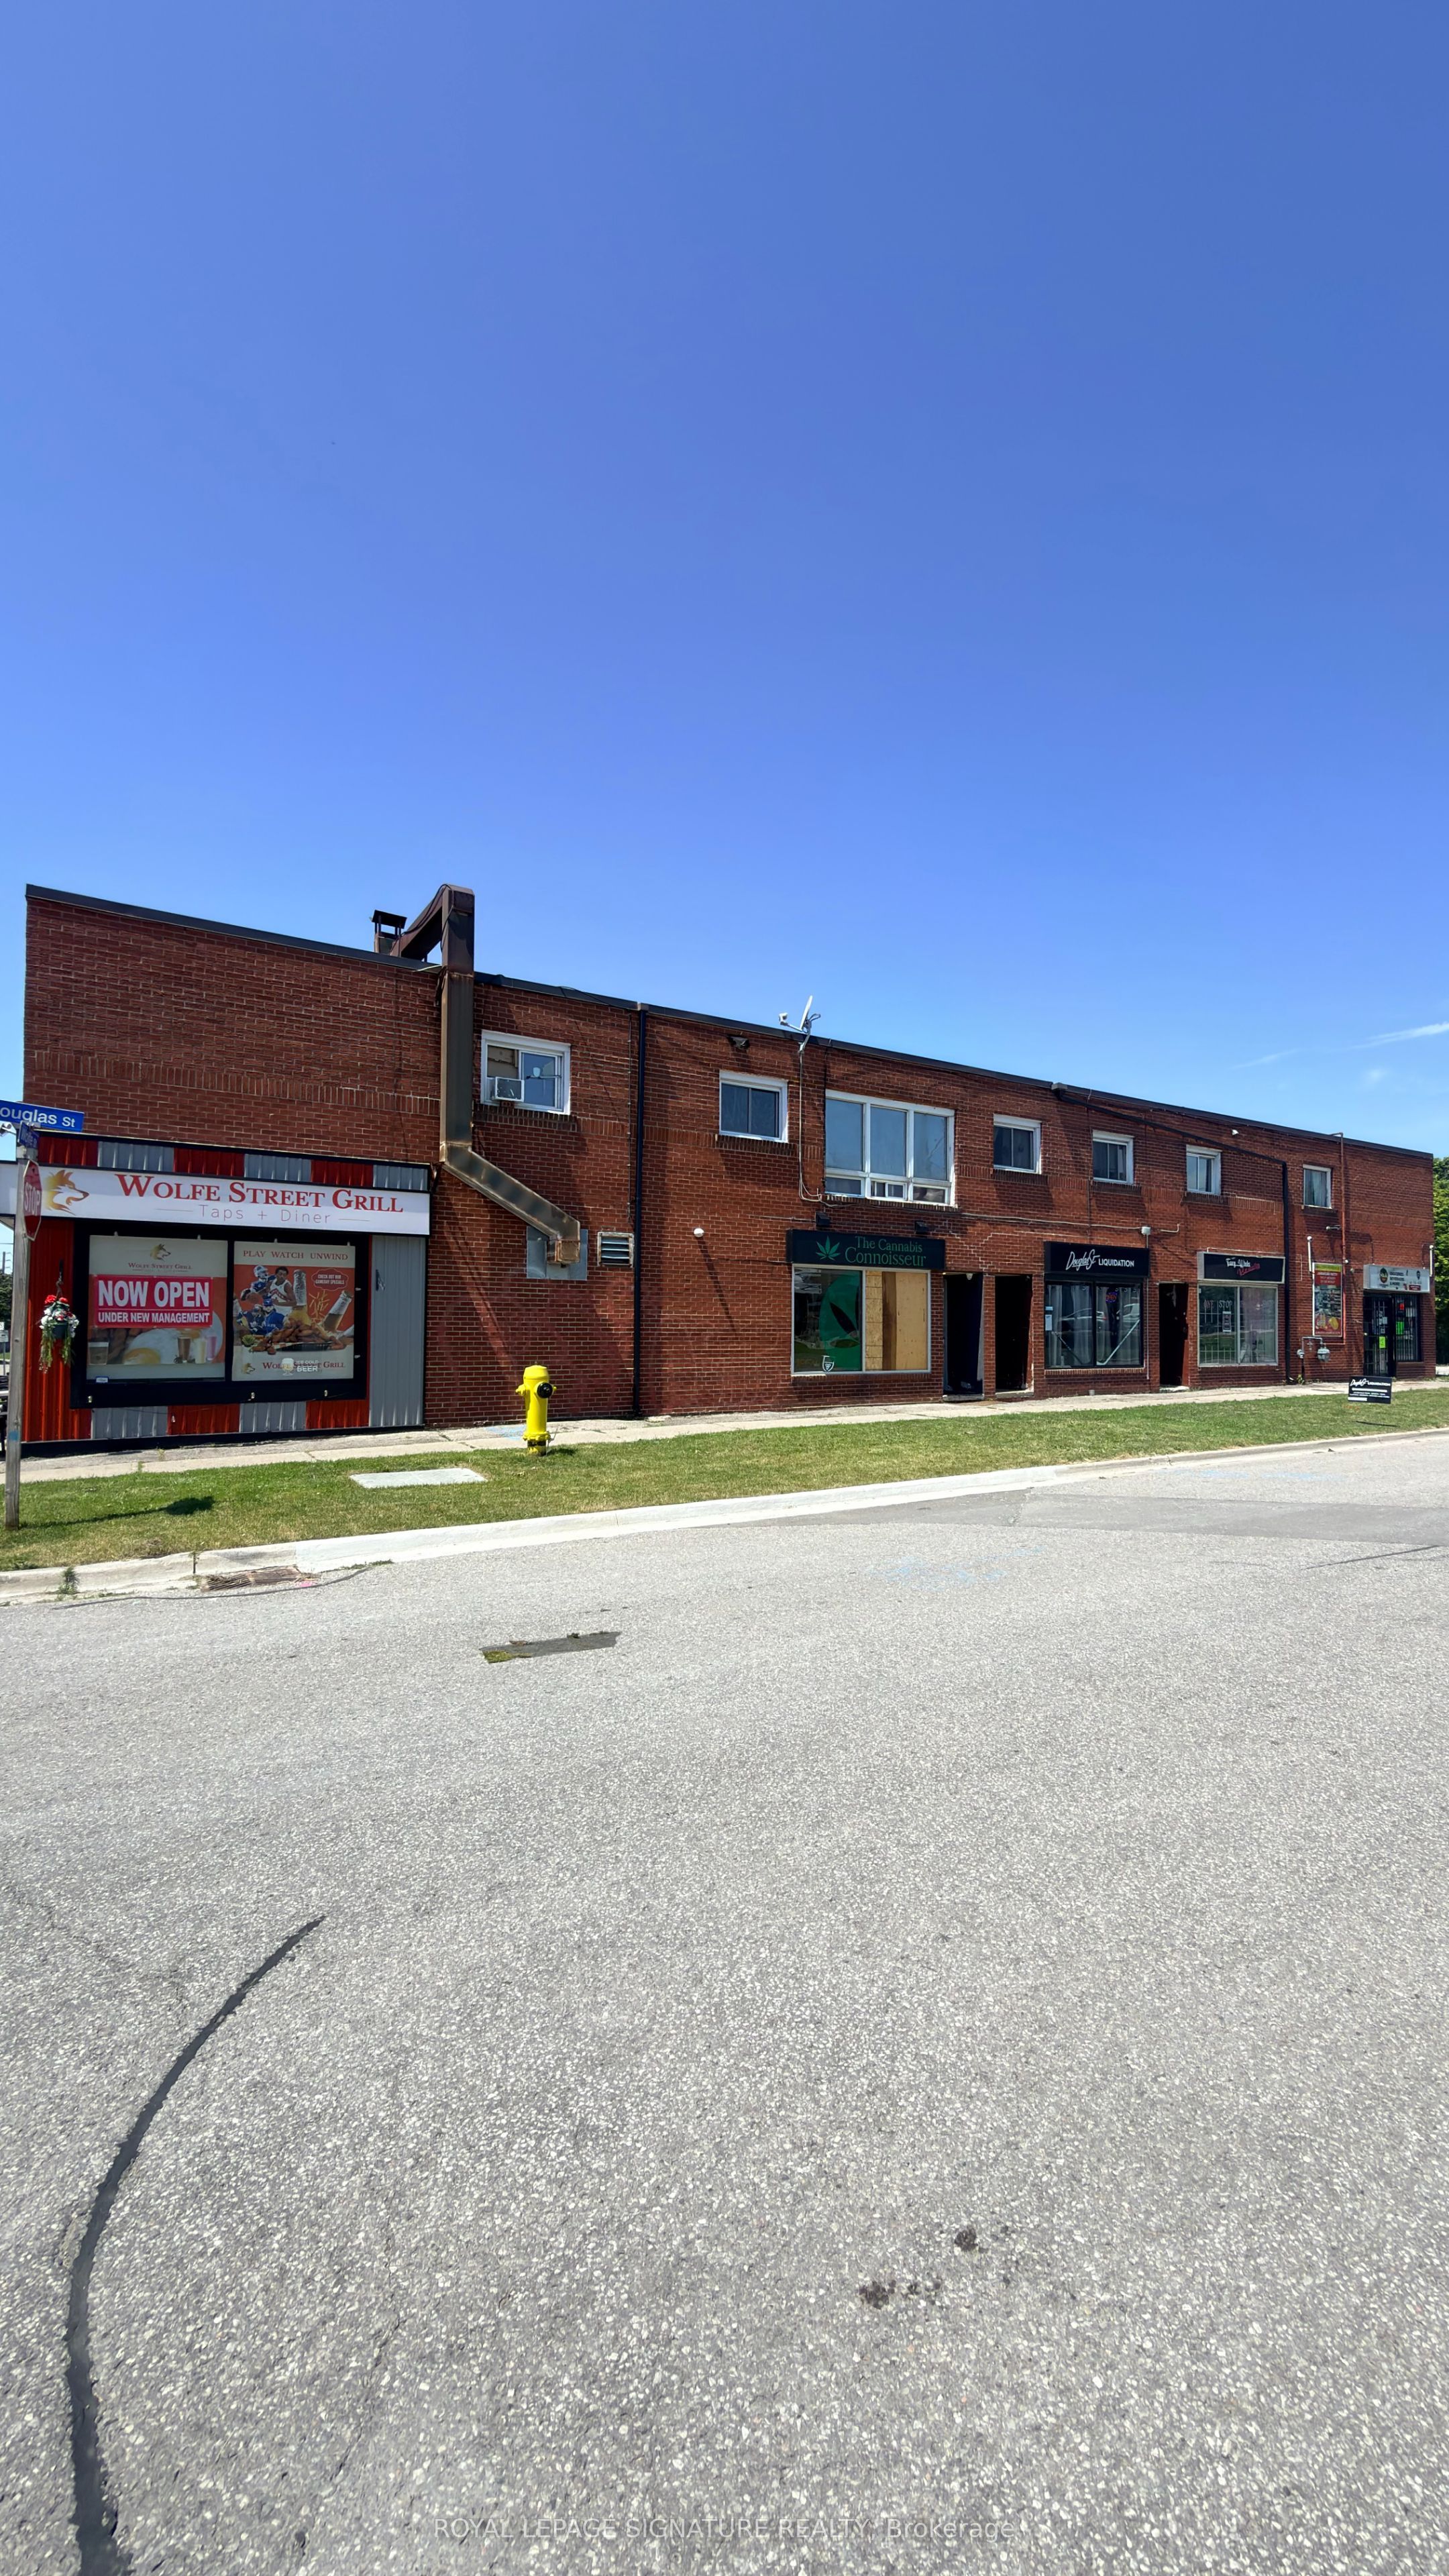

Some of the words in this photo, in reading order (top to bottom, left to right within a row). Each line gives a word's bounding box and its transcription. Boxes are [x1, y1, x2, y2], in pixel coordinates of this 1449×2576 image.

[0, 1107, 57, 1124] ouglas
[62, 1116, 76, 1128] St
[24, 1182, 40, 1216] STOP
[114, 1174, 220, 1202] WOLFE
[229, 1181, 325, 1208] STREET
[332, 1189, 403, 1213] GRILL
[198, 1205, 244, 1221] Taps
[281, 1209, 331, 1224] Diner
[855, 1236, 875, 1248] The
[878, 1238, 923, 1252] Cannabis
[311, 1252, 348, 1260] UNWIND
[845, 1246, 926, 1267] Connoisseur
[1098, 1258, 1135, 1267] LIQUIDATION
[98, 1280, 149, 1307] NOW
[154, 1281, 209, 1307] OPEN
[1218, 1300, 1233, 1308] STOP
[98, 1312, 129, 1323] UNDER
[131, 1312, 150, 1323] NEW
[152, 1313, 210, 1323] MANAGEMENT
